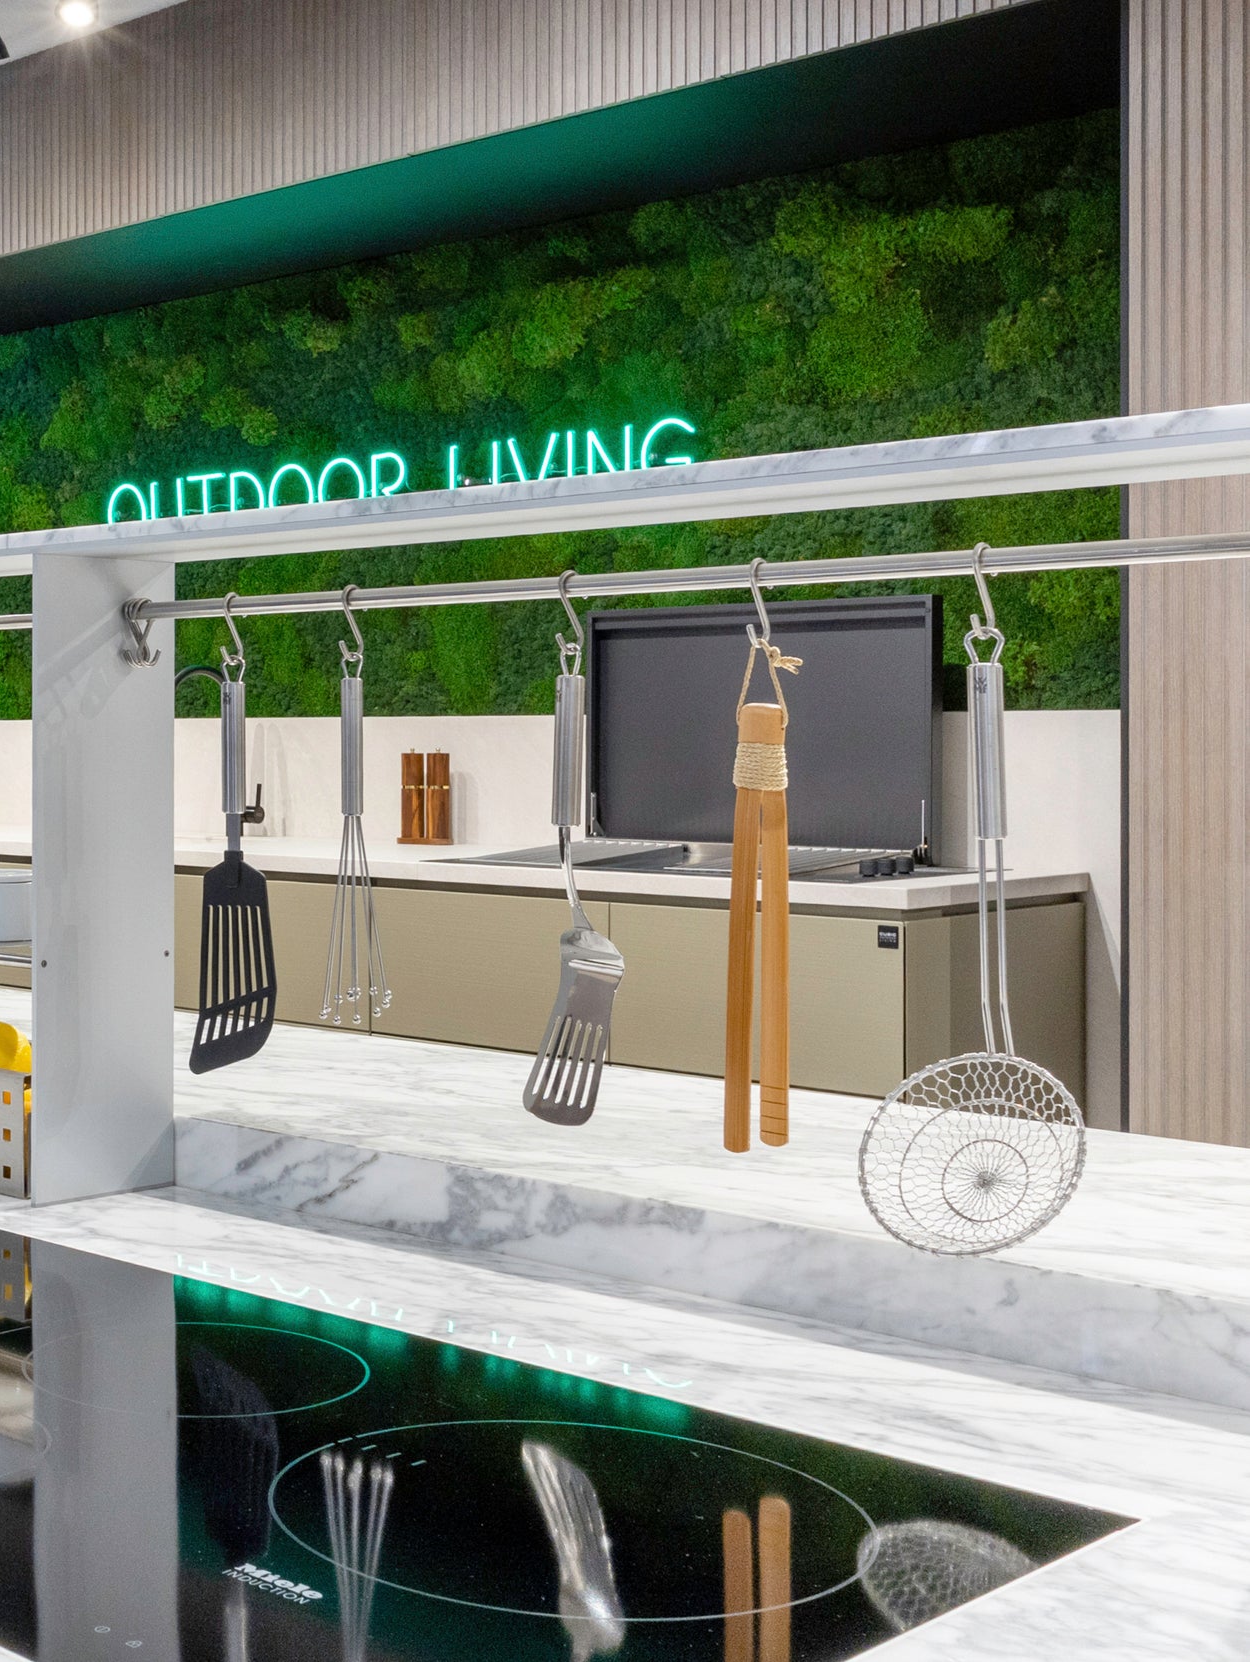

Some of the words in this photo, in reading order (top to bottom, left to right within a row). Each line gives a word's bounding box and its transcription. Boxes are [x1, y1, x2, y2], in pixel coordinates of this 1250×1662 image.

[107, 451, 406, 525] OUTDOOR
[221, 1569, 310, 1604] INDUCTION
[234, 1563, 323, 1599] Miele
